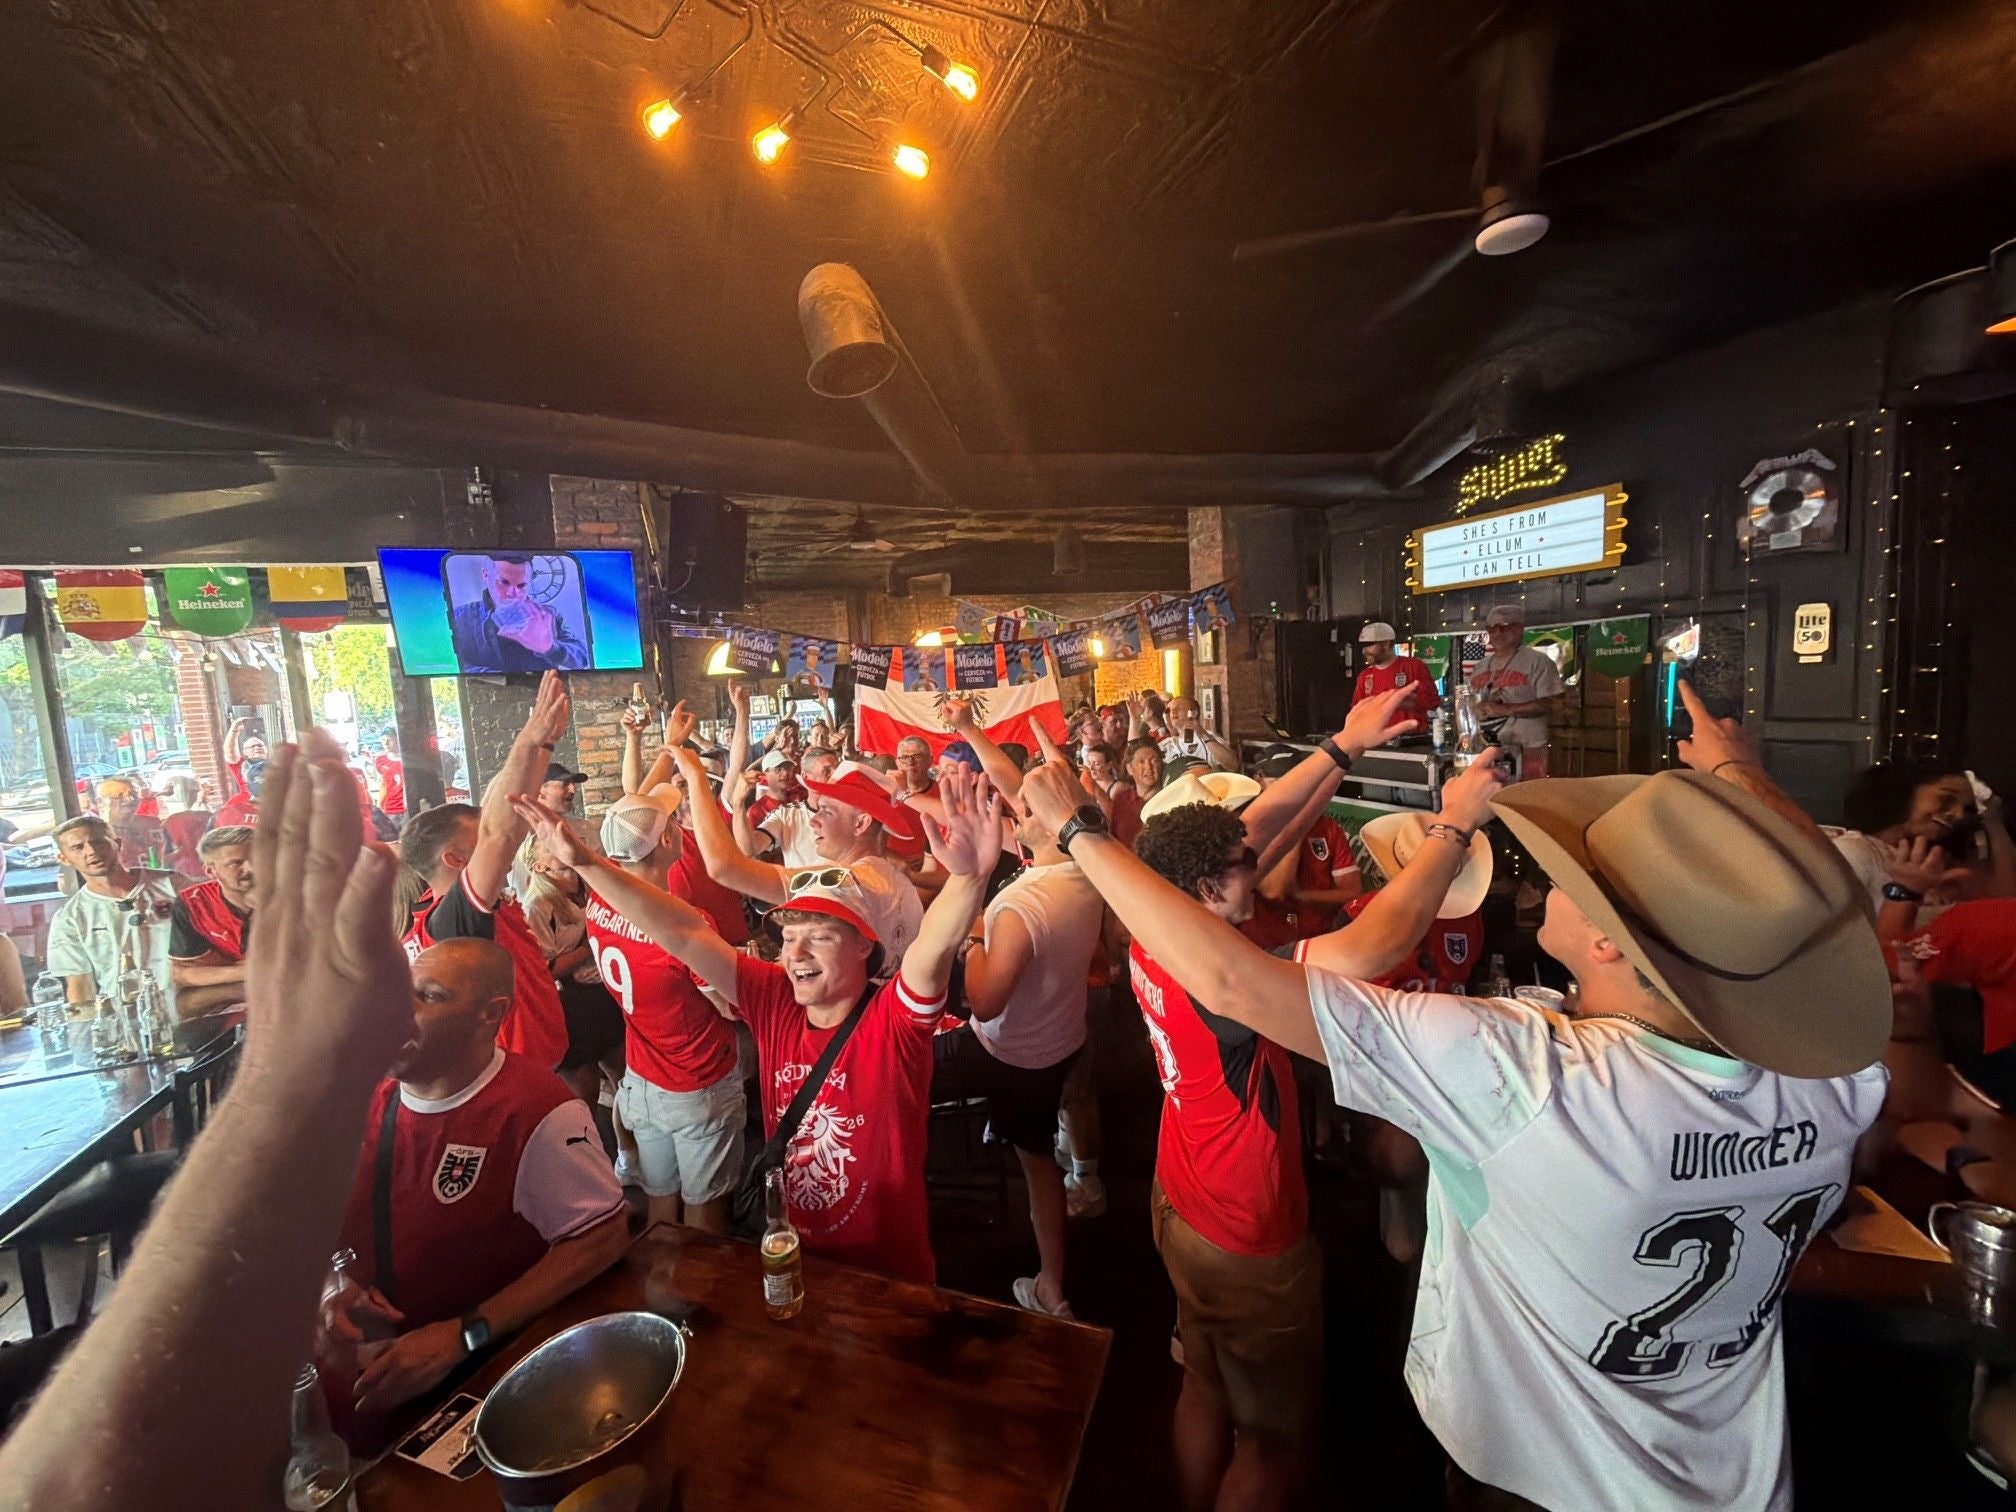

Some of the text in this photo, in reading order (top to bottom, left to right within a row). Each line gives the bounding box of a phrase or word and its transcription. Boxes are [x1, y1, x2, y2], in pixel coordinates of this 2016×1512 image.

[1463, 511, 1546, 541] SHES FROM
[1478, 537, 1522, 556] ELLUM
[1462, 553, 1543, 578] I CAN TELL
[178, 597, 244, 610] Heineken
[1799, 615, 1827, 629] Lite
[733, 630, 774, 653] Modelo
[1057, 637, 1092, 657] Model
[852, 648, 888, 668] Modelo
[956, 654, 993, 668] Modelo
[847, 1114, 865, 1130] 26
[1671, 1120, 1818, 1181] WIMMER
[1588, 1182, 1842, 1384] 21
